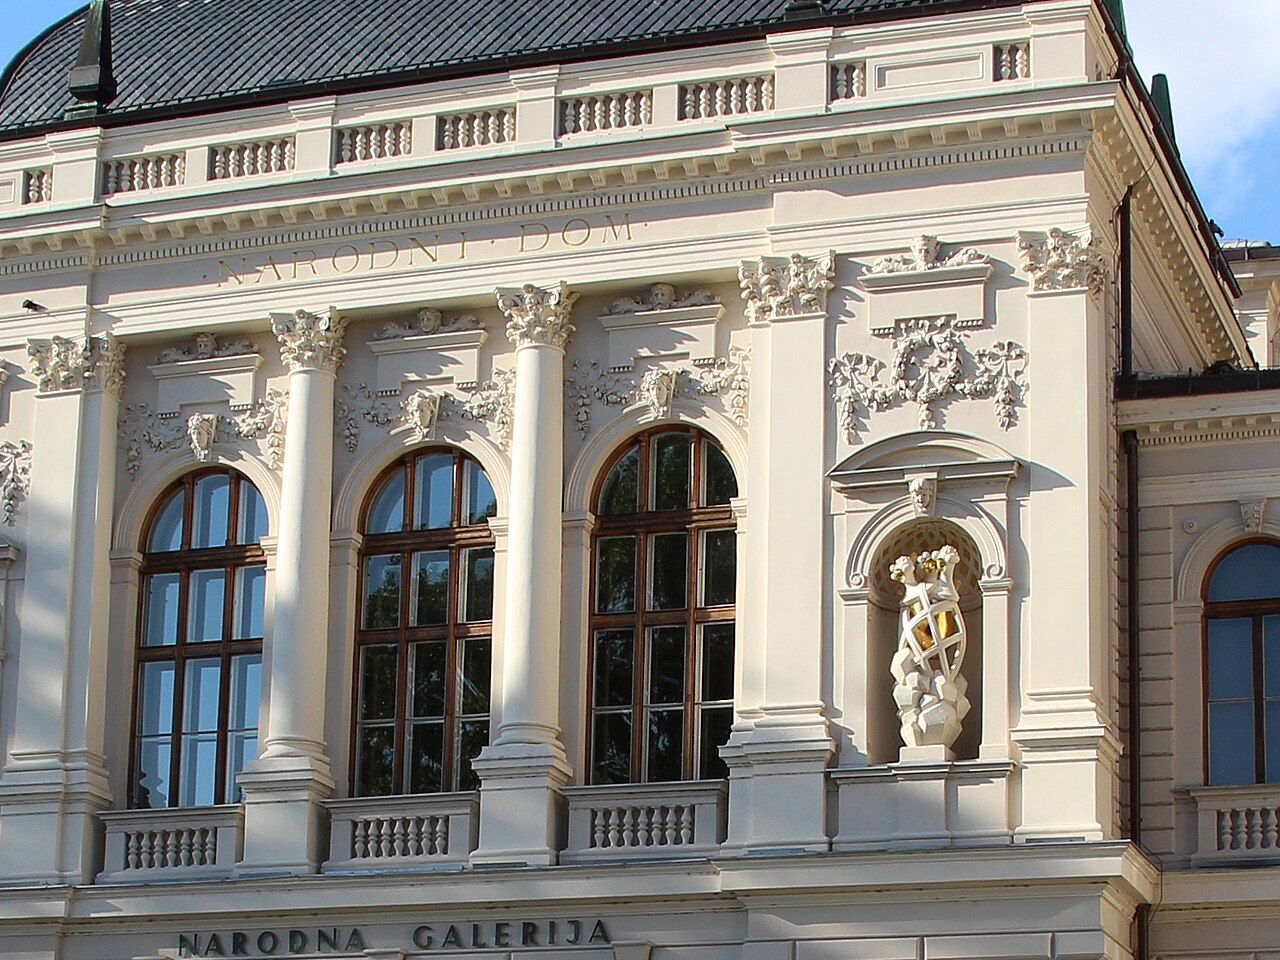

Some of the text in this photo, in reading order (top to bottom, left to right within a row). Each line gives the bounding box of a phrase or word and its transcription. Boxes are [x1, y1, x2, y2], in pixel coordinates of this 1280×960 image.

[217, 213, 636, 288] NARODNI DOM
[178, 919, 614, 957] NARODNA GALERIJA
